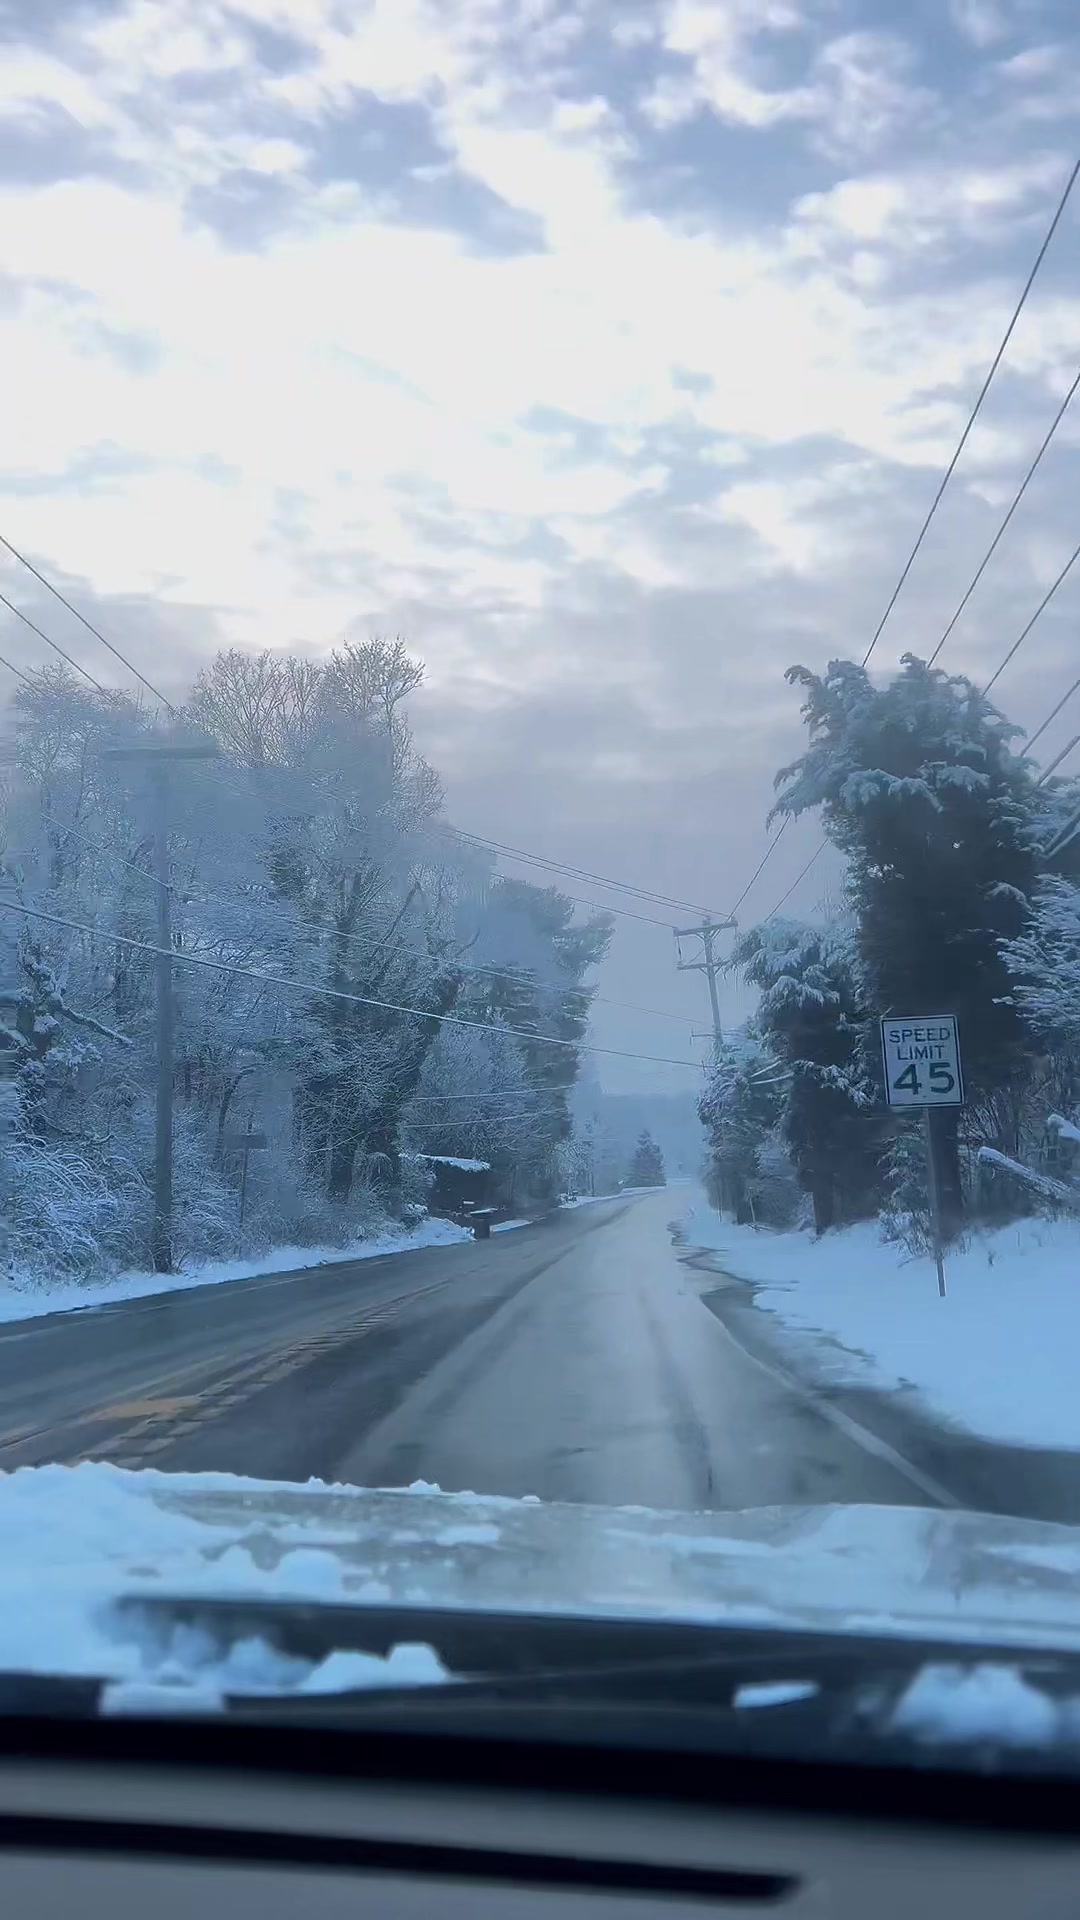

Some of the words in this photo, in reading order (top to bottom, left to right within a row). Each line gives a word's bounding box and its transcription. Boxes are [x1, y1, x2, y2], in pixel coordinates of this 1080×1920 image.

[889, 1027, 950, 1043] SPEED
[897, 1045, 945, 1060] LIMIT
[893, 1062, 955, 1095] 45
